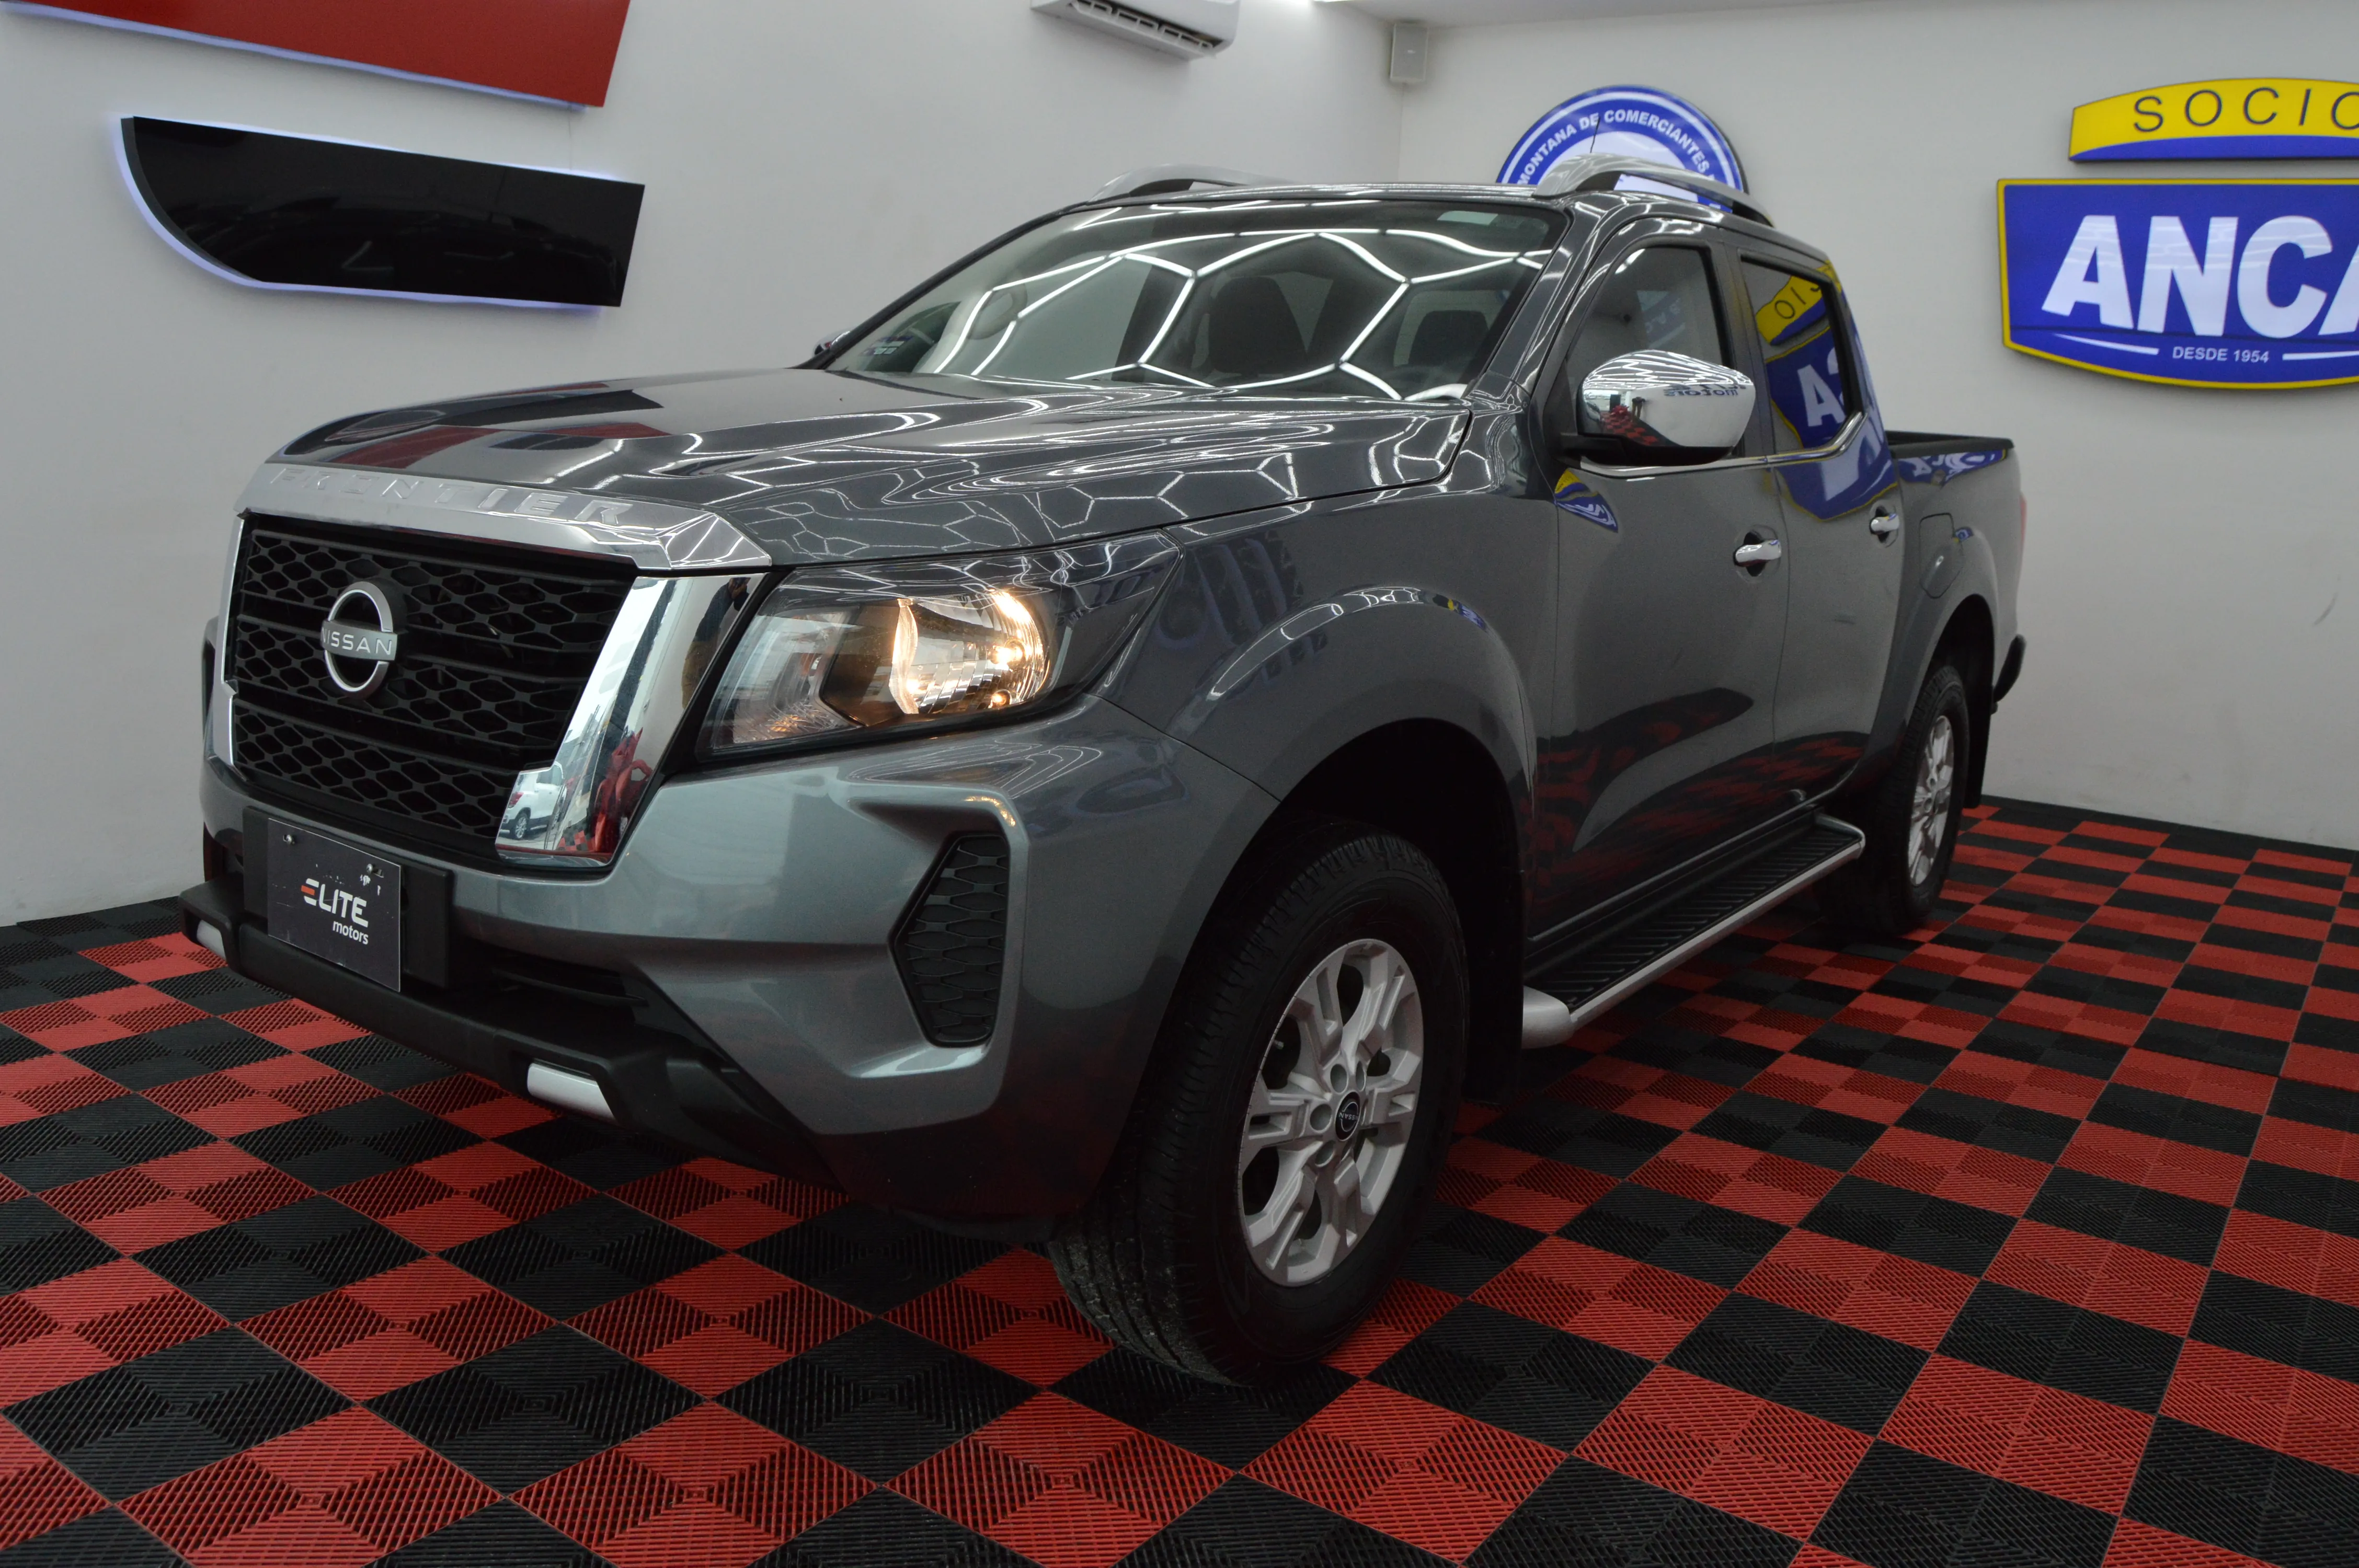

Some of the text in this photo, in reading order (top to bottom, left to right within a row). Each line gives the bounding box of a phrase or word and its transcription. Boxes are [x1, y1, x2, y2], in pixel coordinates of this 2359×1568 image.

[2133, 86, 2359, 133] SOCIO
[1578, 112, 1599, 130] DE
[1604, 109, 1710, 174] COMERCIANTES
[2172, 346, 2270, 363] DESDE 1954
[269, 467, 634, 525] FRONTIER
[320, 627, 393, 655] NISSAN
[301, 878, 369, 928] ELITE
[333, 920, 369, 945] motors
